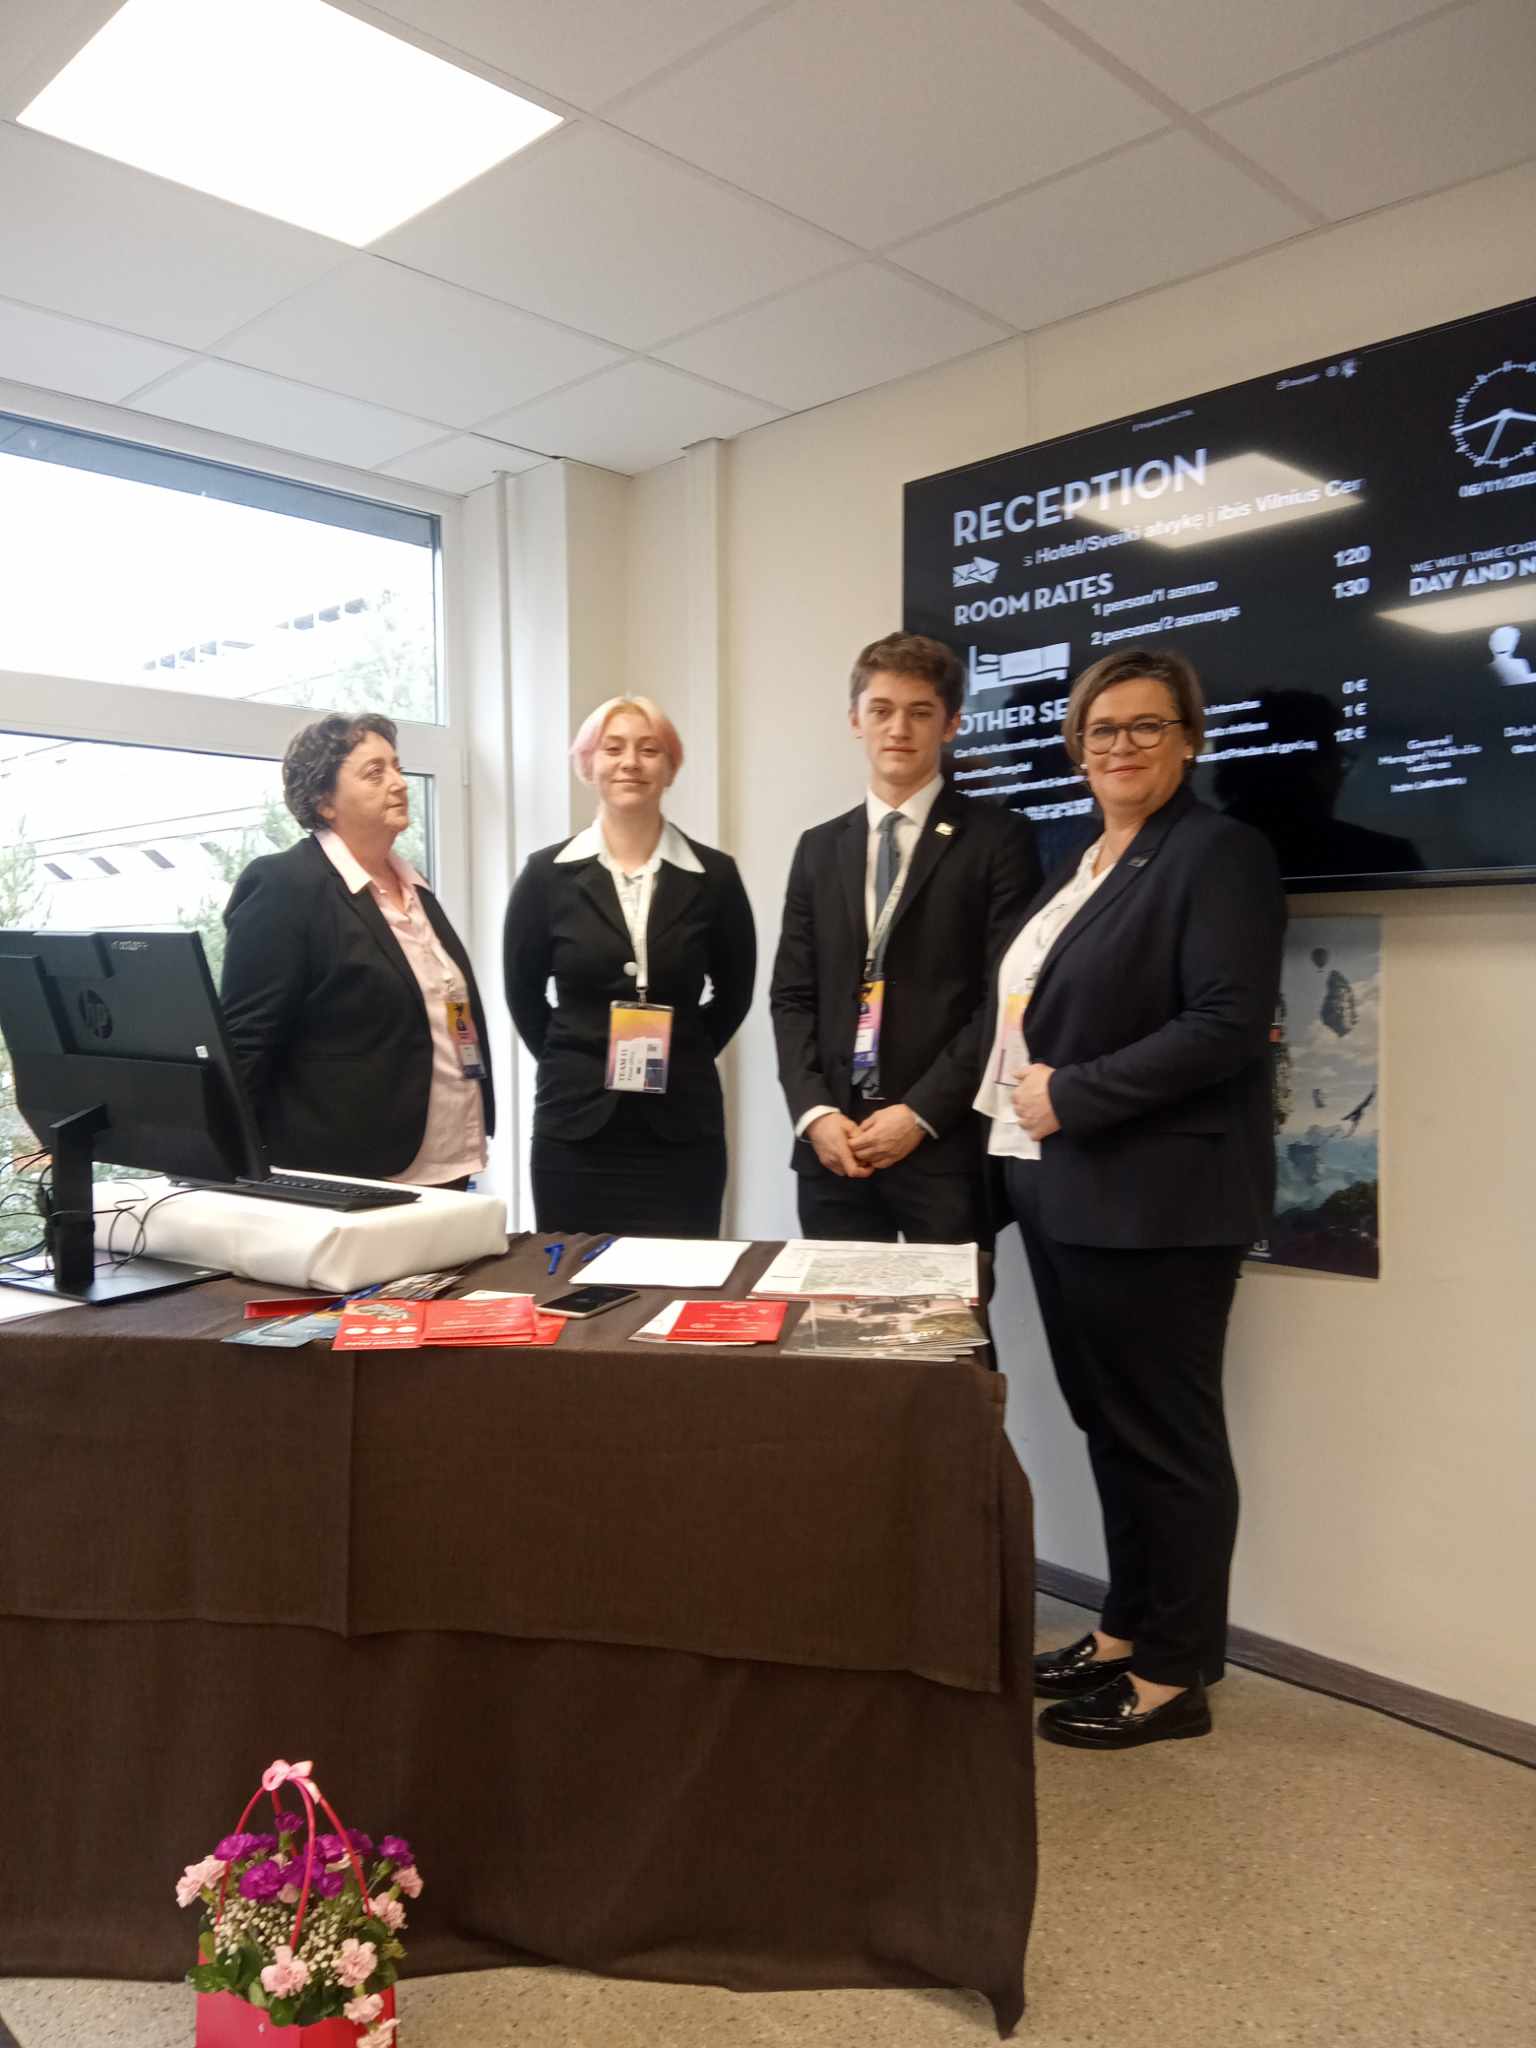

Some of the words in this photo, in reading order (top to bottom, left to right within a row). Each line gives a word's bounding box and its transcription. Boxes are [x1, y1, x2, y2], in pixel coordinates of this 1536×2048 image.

[954, 448, 1207, 546] RECEPTION
[1217, 502, 1252, 521] ibis
[1256, 488, 1321, 512] Vilnius
[1333, 545, 1371, 567] 120
[1332, 577, 1370, 599] 130
[1409, 569, 1459, 597] DAY
[1462, 561, 1517, 587] AND
[954, 591, 1030, 626] ROOM
[1034, 572, 1113, 611] RATES
[956, 704, 1036, 736] OTHER
